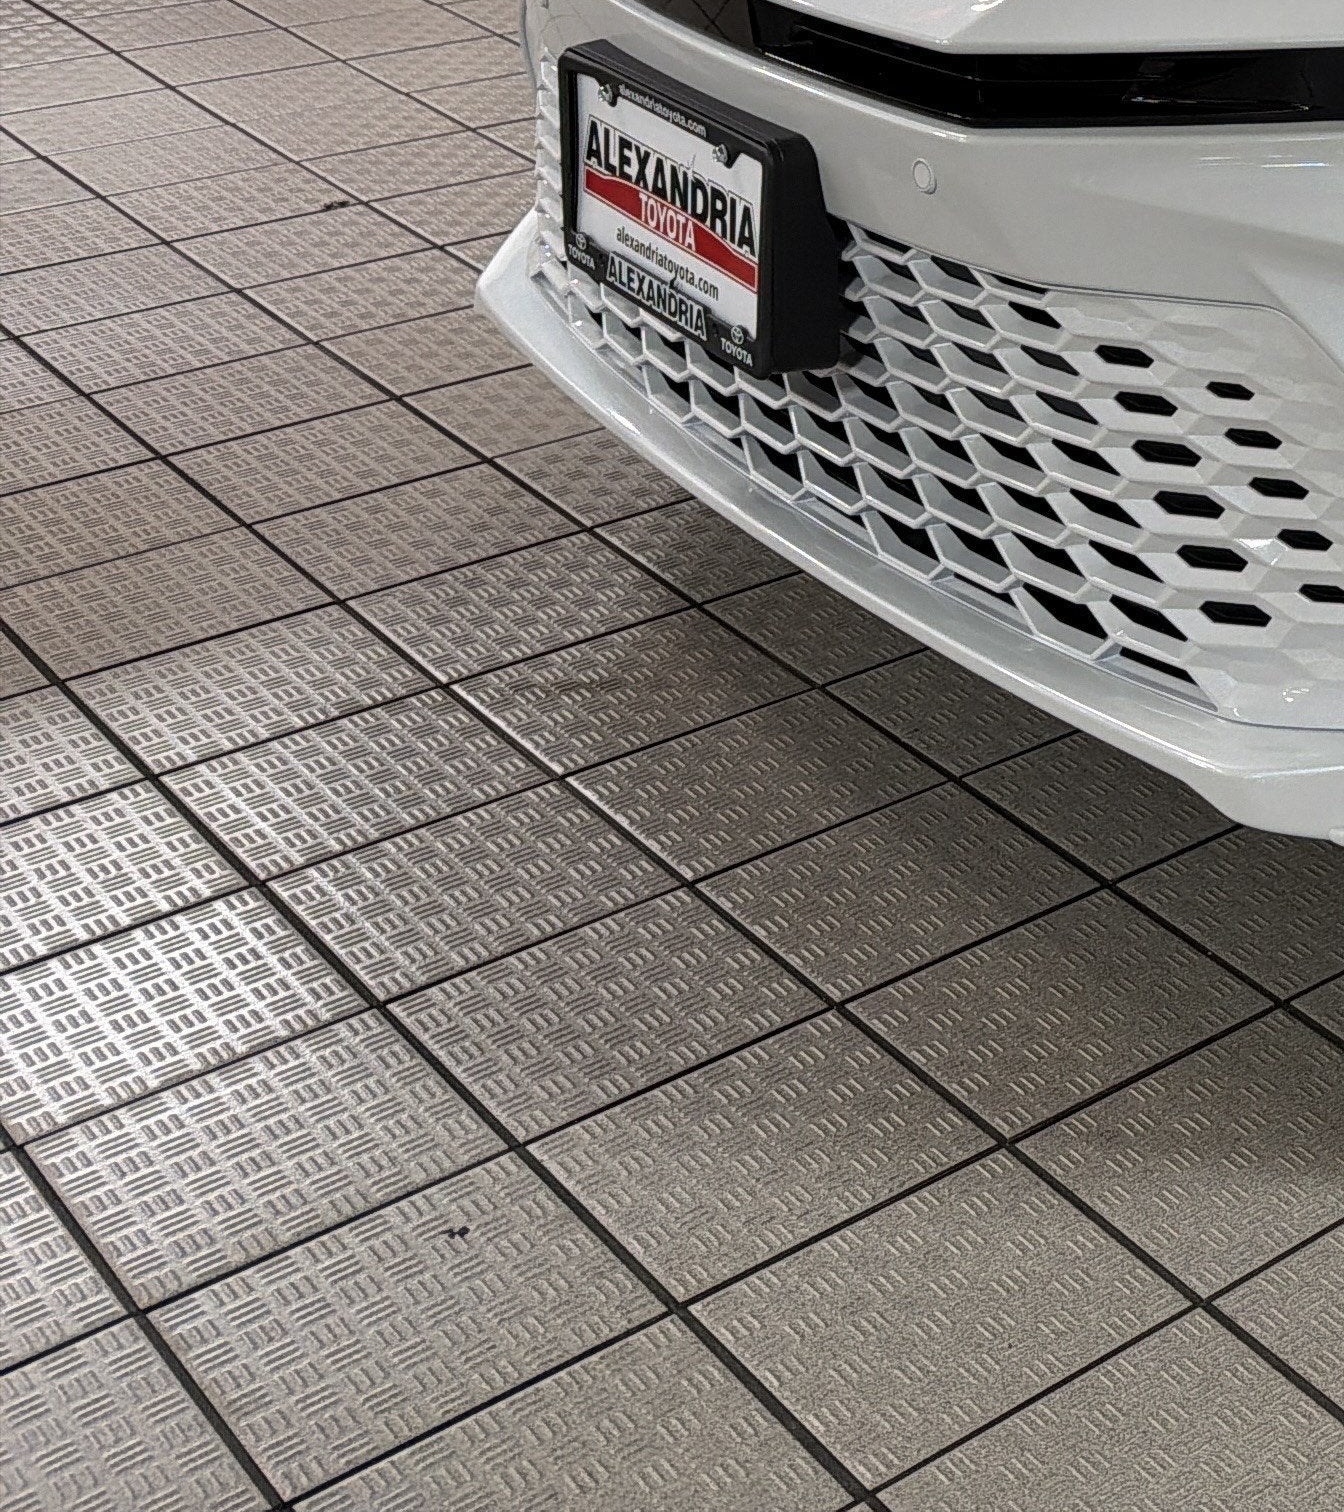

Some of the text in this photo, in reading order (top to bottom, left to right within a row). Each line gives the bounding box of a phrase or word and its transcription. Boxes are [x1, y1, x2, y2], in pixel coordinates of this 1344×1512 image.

[619, 83, 707, 139] alexandriatoyota.com
[585, 118, 757, 258] ALEXANDRIA
[638, 190, 697, 252] TOYOTA
[567, 243, 596, 271] TOYOTA
[616, 225, 720, 301] alexandriatoyota.com
[606, 254, 708, 342] ALEXANDRIA
[720, 337, 754, 368] TOYOTA
